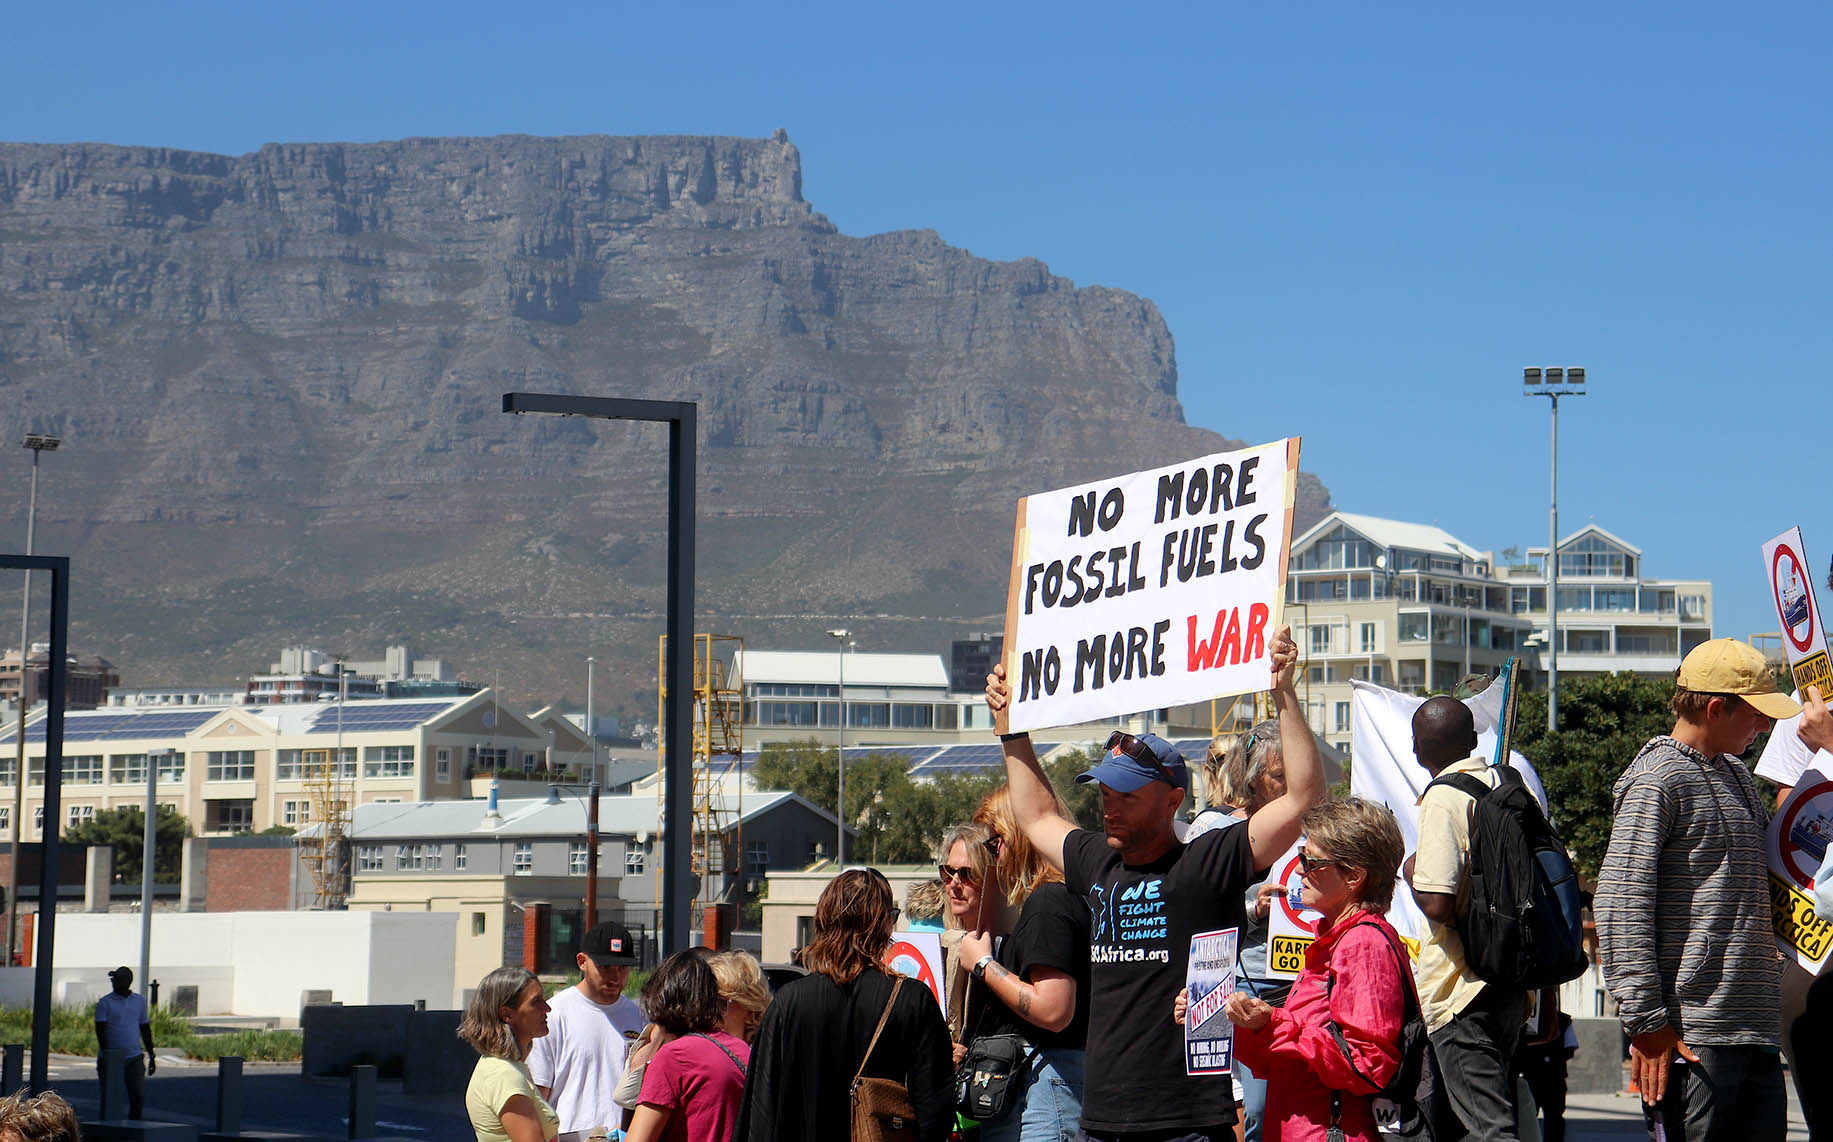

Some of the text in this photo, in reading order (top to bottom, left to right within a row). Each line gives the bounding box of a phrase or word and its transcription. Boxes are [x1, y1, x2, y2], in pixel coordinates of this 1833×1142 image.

[1068, 456, 1260, 537] NO MORE
[1024, 513, 1268, 615] FOSSIL FUELS
[1018, 602, 1269, 703] NO MORE WAR
[1795, 657, 1828, 686] HANDS OFF
[1121, 880, 1162, 901] WE
[1119, 902, 1165, 915] FIGHT
[1120, 916, 1167, 928] CLIMATE
[1800, 908, 1832, 937] OFF
[1121, 928, 1167, 940] CHANGE
[1279, 956, 1299, 969] GO
[1191, 1001, 1204, 1028] NOT
[1206, 991, 1218, 1016] FOR
